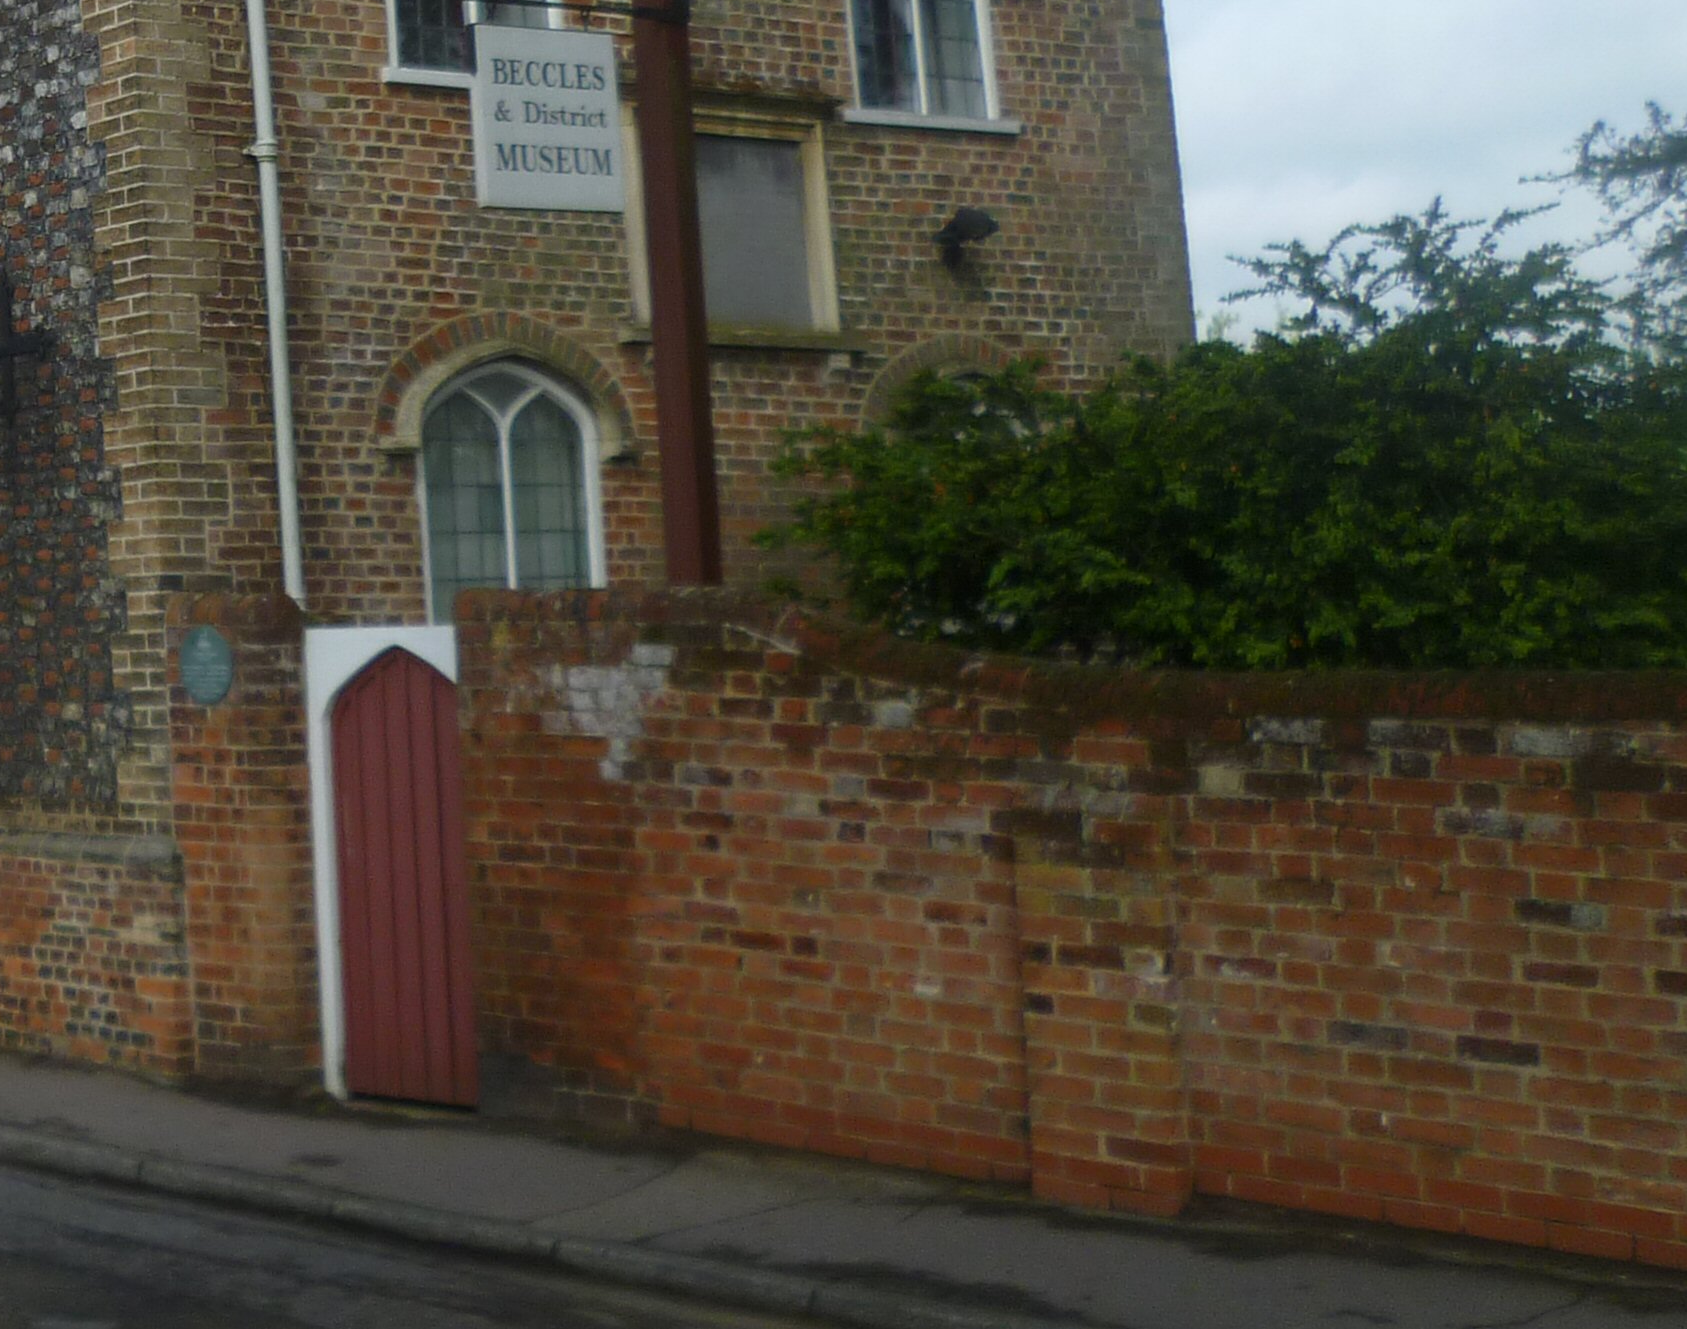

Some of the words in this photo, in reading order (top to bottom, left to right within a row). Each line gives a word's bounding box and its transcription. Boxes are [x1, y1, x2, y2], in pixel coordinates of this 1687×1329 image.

[490, 57, 606, 92] BECCLES
[493, 99, 512, 123] &
[522, 100, 608, 129] District
[494, 143, 615, 177] MUSEUM
